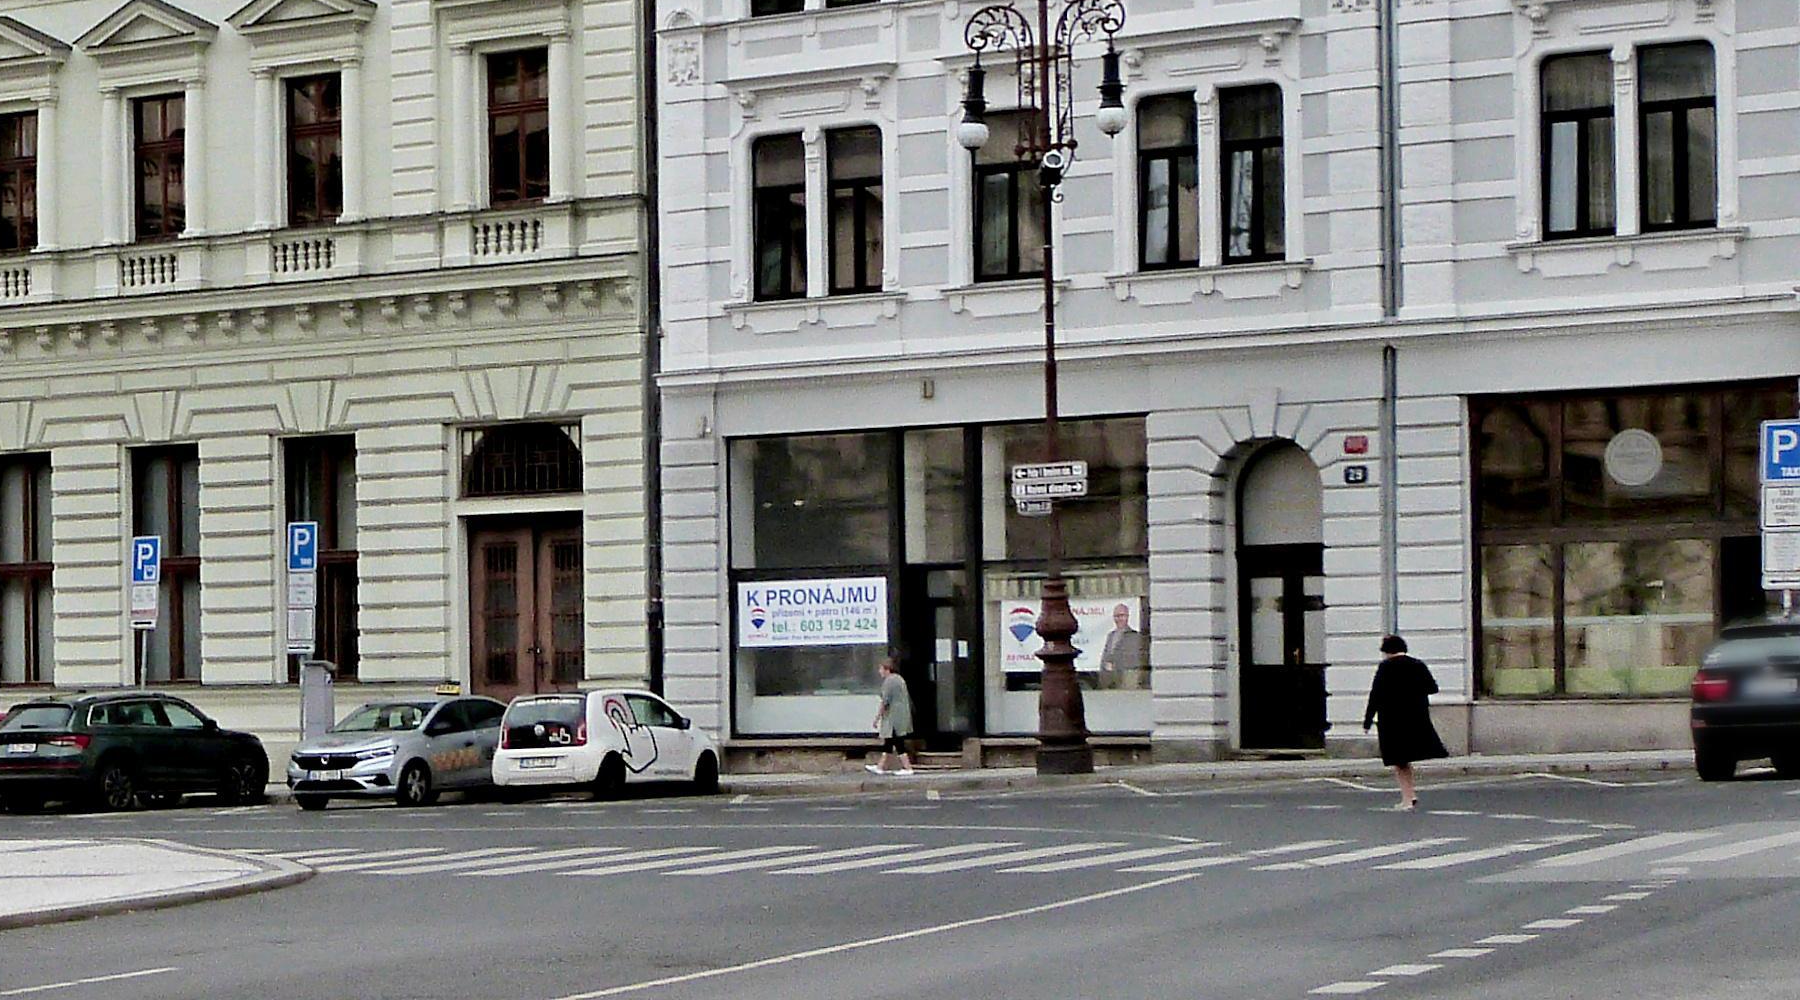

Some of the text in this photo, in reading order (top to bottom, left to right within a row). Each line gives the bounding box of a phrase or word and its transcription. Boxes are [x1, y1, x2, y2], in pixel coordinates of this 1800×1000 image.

[1772, 429, 1798, 464] P
[293, 528, 311, 556] P
[137, 543, 154, 570] P
[746, 584, 878, 607] K PRONÁJMU
[800, 619, 823, 632] 603
[829, 618, 850, 631] 192
[855, 617, 878, 630] 424
